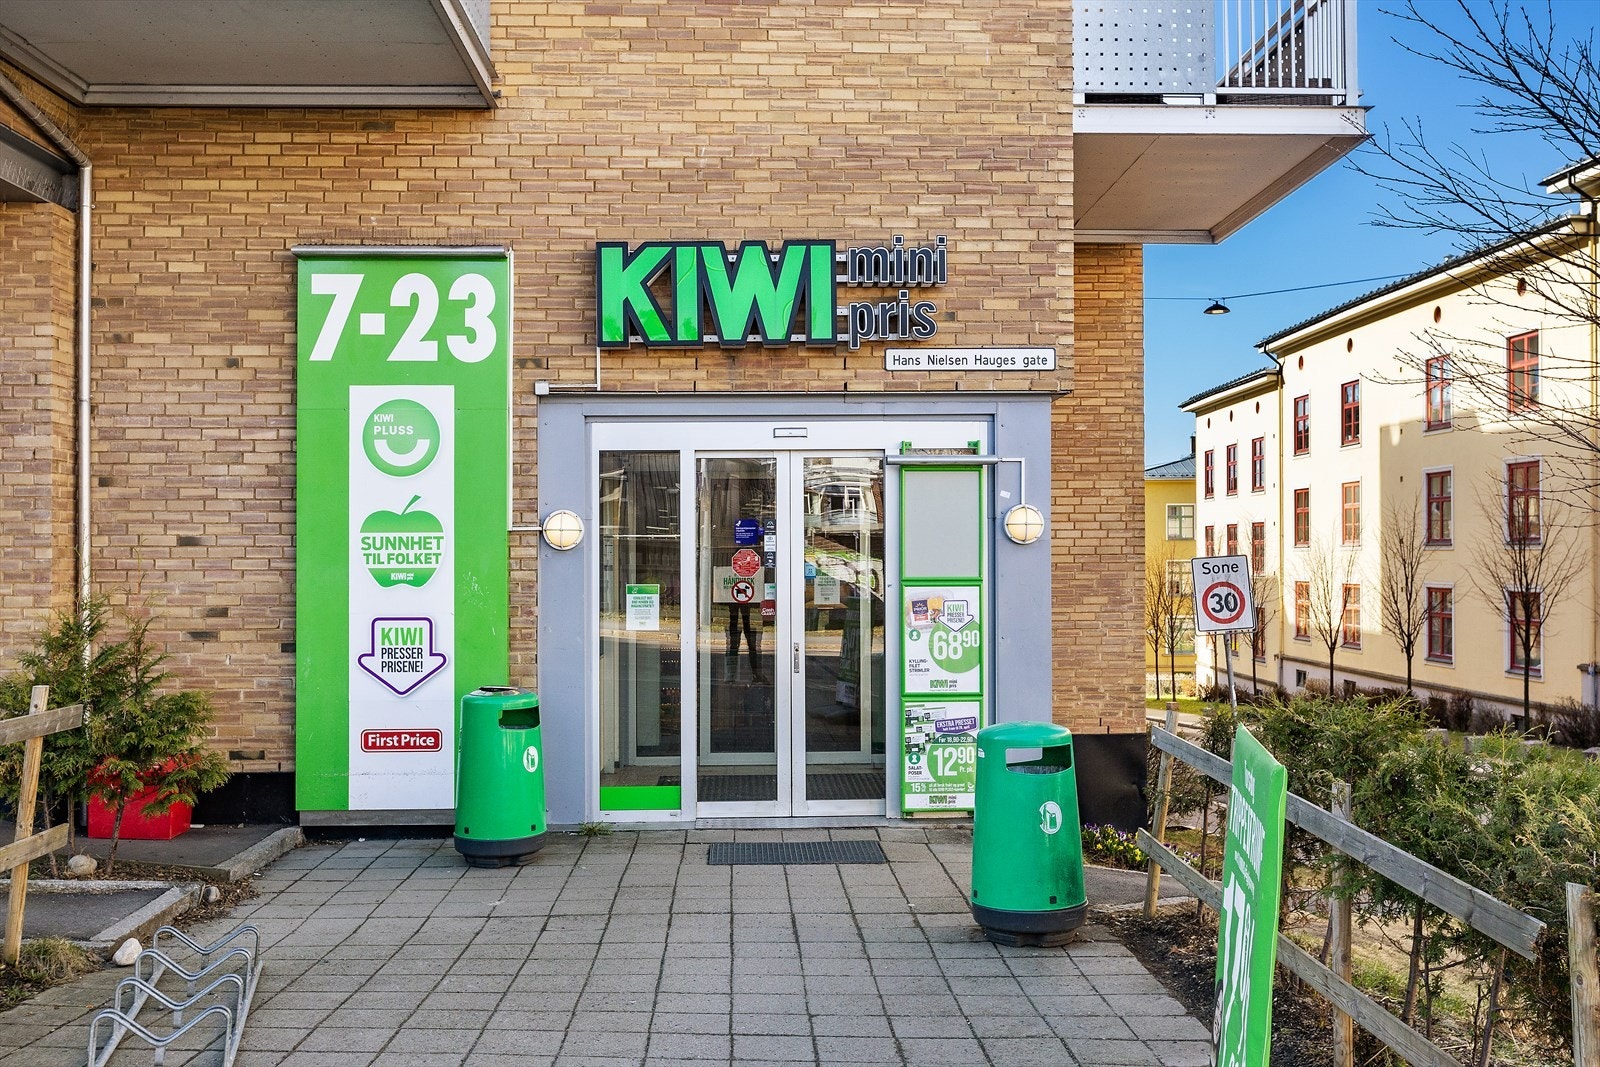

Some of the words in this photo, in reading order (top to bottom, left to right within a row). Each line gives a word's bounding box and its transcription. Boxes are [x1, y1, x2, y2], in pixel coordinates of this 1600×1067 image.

[847, 234, 948, 285] mini
[596, 239, 836, 347] KIWI
[309, 272, 497, 363] 7-23
[848, 289, 938, 350] pris
[892, 353, 921, 367] Hans
[926, 353, 968, 367] Nielsen
[974, 353, 1016, 369] Hauges
[1022, 355, 1049, 369] gate
[374, 414, 394, 423] KIWI
[374, 426, 414, 435] PLUSS
[360, 536, 444, 551] SUNNHET
[363, 553, 385, 565] TIL
[386, 553, 442, 565] FOLKET
[1201, 562, 1239, 575] Sone
[946, 603, 965, 612] KIWI
[1209, 592, 1239, 614] 30
[380, 627, 424, 646] KIWI
[380, 647, 424, 660] PRESSER
[380, 660, 424, 673] PRISENE!
[929, 679, 949, 689] KIWI
[367, 734, 399, 747] First
[400, 734, 435, 747] Price
[928, 795, 948, 805] KIWI
